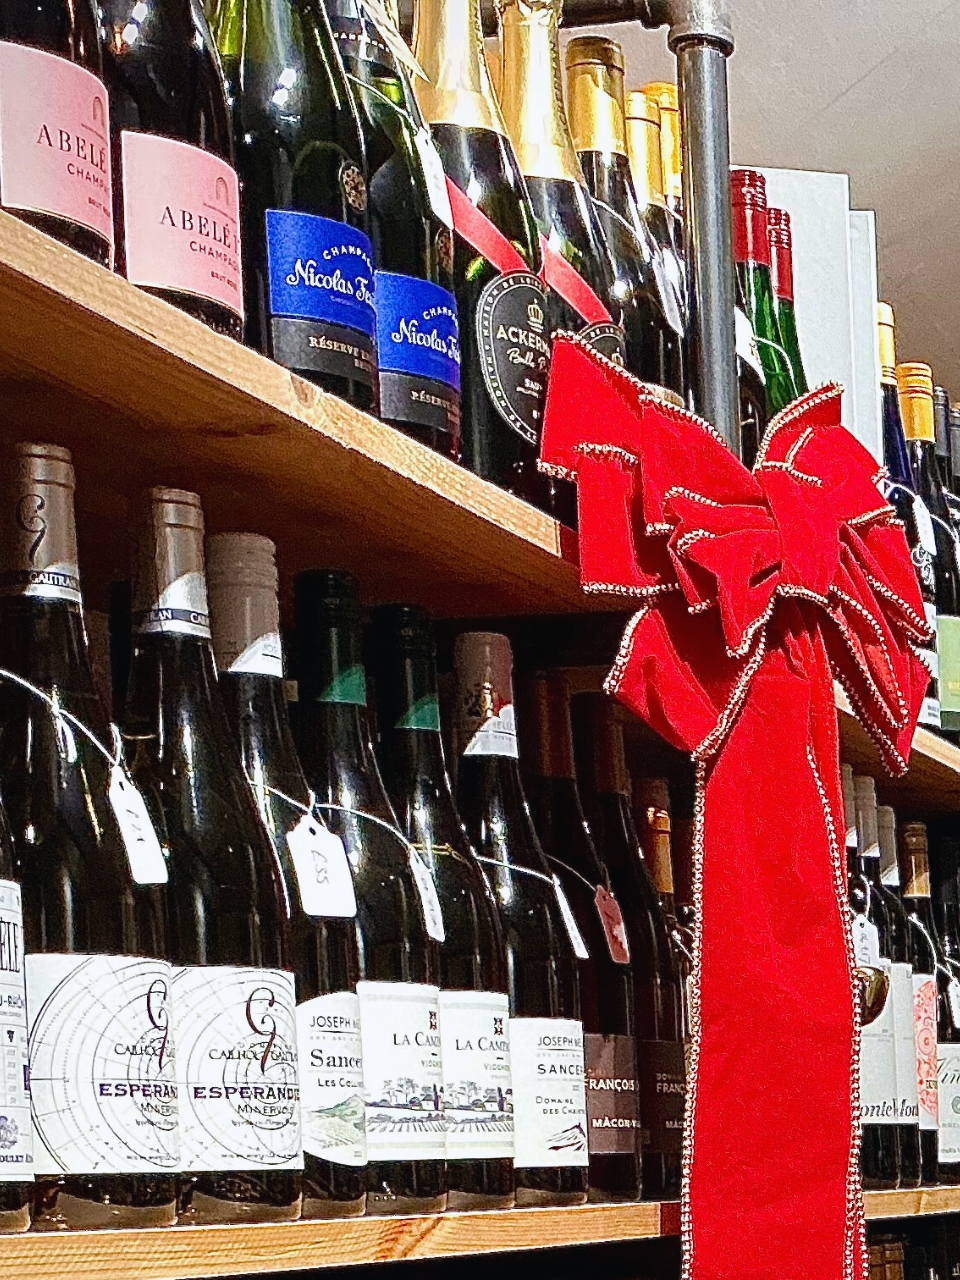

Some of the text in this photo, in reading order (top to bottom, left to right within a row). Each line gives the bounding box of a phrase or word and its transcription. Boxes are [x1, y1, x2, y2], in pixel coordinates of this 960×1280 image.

[285, 258, 354, 297] Nicolas
[390, 317, 448, 354] Nicolas
[310, 1015, 351, 1029] JOSEPH
[537, 1036, 573, 1047] JOSEPH
